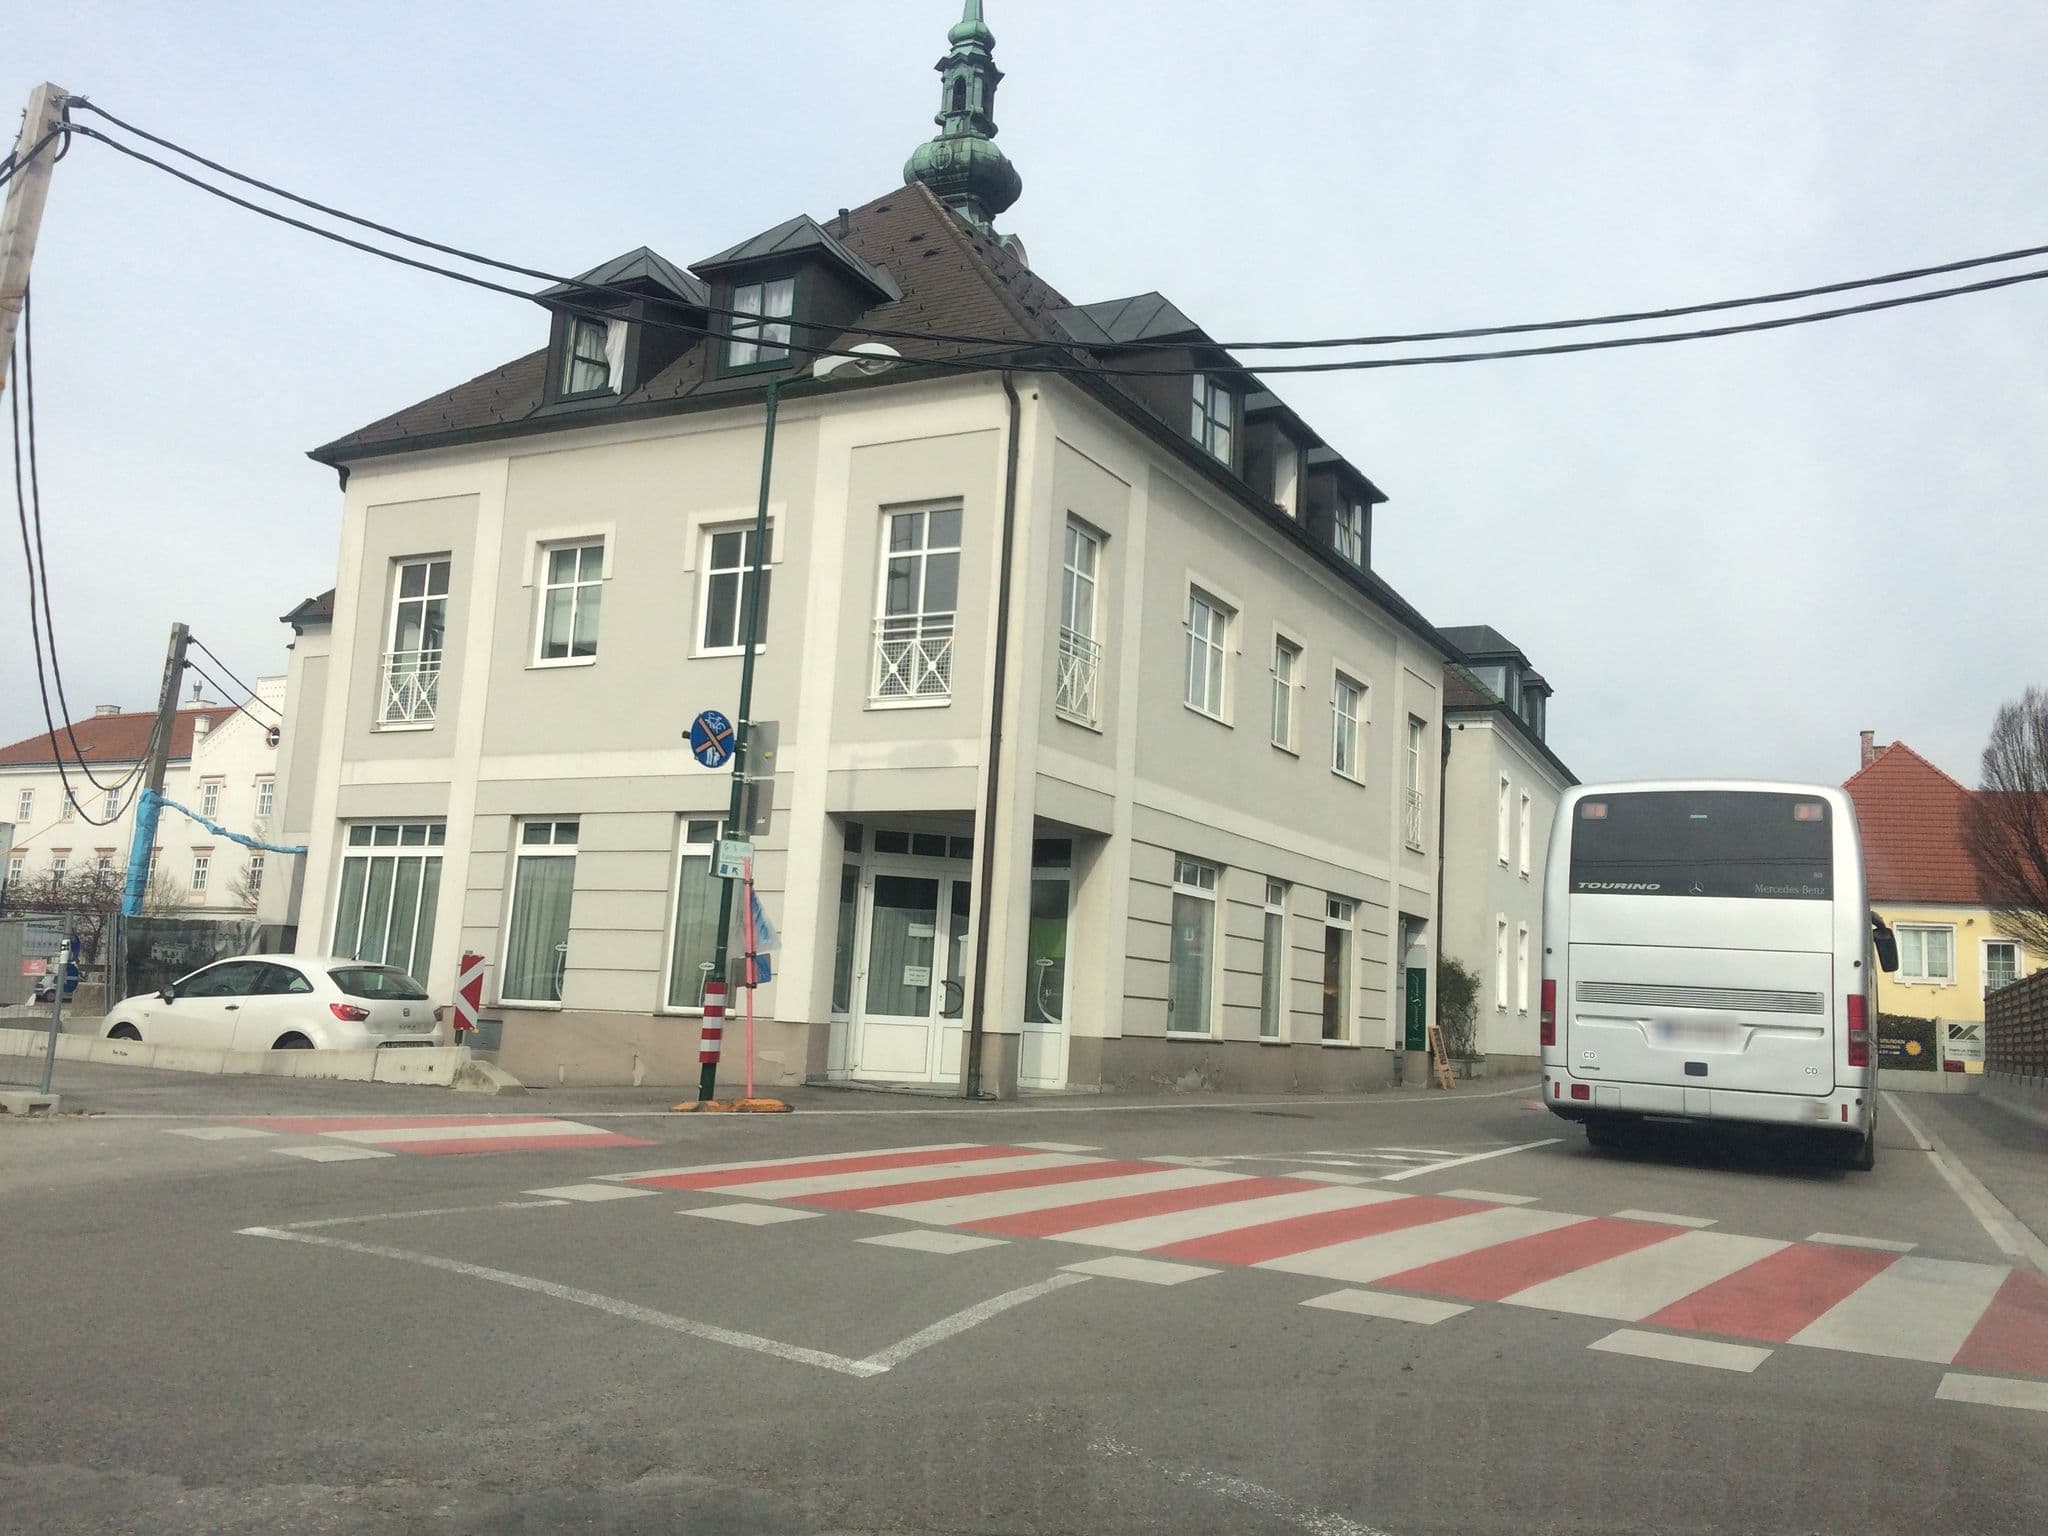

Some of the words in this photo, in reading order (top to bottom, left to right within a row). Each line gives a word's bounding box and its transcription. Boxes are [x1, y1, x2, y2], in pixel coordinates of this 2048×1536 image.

[1577, 881, 1661, 892] TOURINO
[1583, 1051, 1596, 1060] CD
[1804, 1066, 1818, 1075] CD
